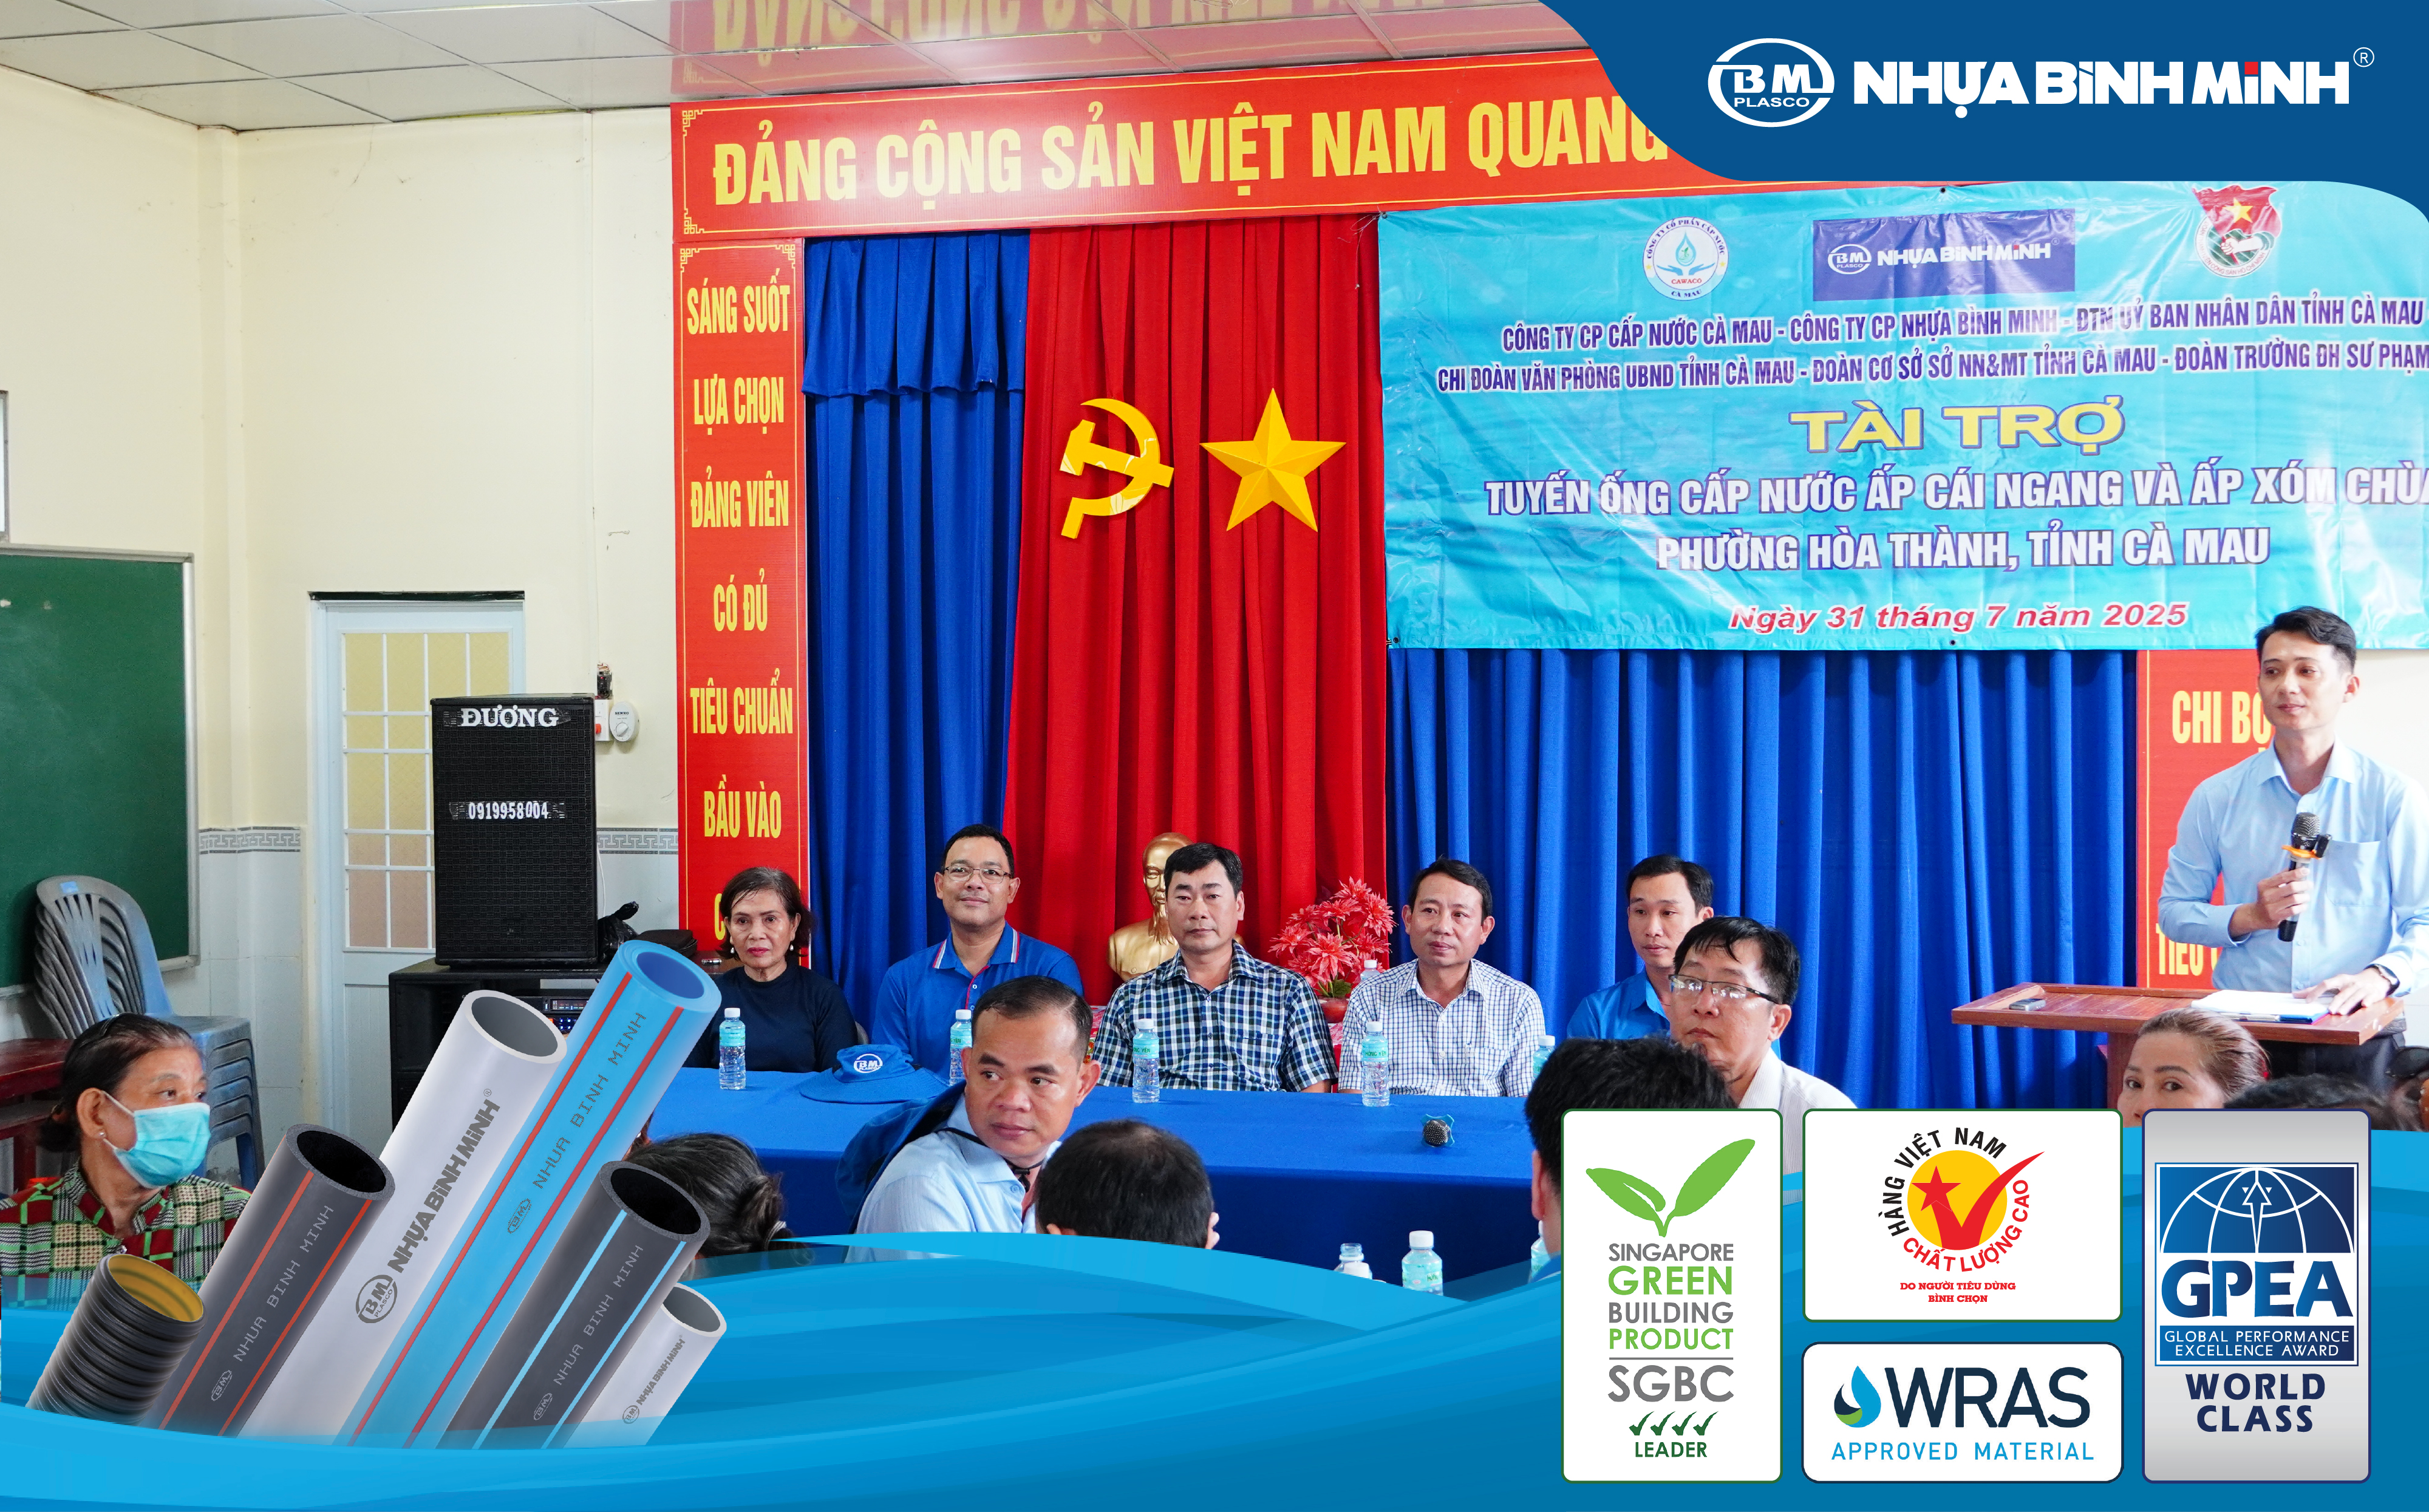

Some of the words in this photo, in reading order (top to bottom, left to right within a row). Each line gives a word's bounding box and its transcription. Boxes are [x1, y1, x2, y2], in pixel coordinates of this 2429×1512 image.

[713, 120, 857, 205] ĐẢNG
[876, 120, 1021, 210] CỘNG
[1041, 101, 1154, 190] SẢN
[1173, 101, 1292, 196] VIỆT
[1312, 105, 1446, 177] NAM
[1468, 95, 1668, 177] QUANG
[1878, 248, 1938, 268] NHỰA
[687, 278, 737, 334] SÁNG
[743, 268, 790, 333] SUỐT
[1503, 321, 1550, 352] CÔNG
[1555, 326, 1575, 349] TY
[1579, 325, 1602, 348] CP
[1608, 315, 1643, 347] CẤP
[1649, 316, 1697, 346] NƯỚC
[1703, 316, 1726, 345] CÀ
[1732, 319, 1772, 343] MAU
[1790, 313, 1839, 341] CÔNG
[1845, 316, 1866, 340] TY
[1872, 316, 1895, 339] CP
[1902, 312, 1952, 341] NHỰA
[1957, 307, 2001, 335] BÌNH
[2008, 308, 2057, 334] MINH
[2077, 307, 2113, 332] ĐTN
[2119, 297, 2144, 330] UỶ
[2150, 304, 2189, 329] BAN
[2195, 297, 2249, 327] NHÂN
[2255, 295, 2295, 325] DÂN
[2301, 291, 2344, 324] TỈNH
[2351, 294, 2376, 324] CÀ
[2381, 300, 2424, 325] MAU
[1684, 289, 1702, 298] MAU
[1438, 368, 1466, 391] CHI
[1471, 363, 1516, 390] ĐOÀN
[1521, 363, 1556, 390] VĂN
[1561, 360, 1620, 389] PHÒNG
[1626, 364, 1674, 389] UBND
[1680, 355, 1719, 386] TỈNH
[1726, 356, 1749, 385] CÀ
[1755, 361, 1794, 384] MAU
[1813, 355, 1862, 383] ĐOÀN
[1869, 356, 1893, 381] CƠ
[1898, 347, 1923, 380] SỞ
[1928, 346, 1953, 378] SỞ
[1959, 351, 2028, 378] NN&MT
[2033, 343, 2076, 375] TỈNH
[2082, 344, 2108, 374] CÀ
[2114, 347, 2156, 372] MAU
[2175, 341, 2227, 372] ĐOÀN
[2234, 337, 2310, 369] TRƯỜNG
[2316, 343, 2339, 368] ĐH
[2346, 340, 2374, 369] SƯ
[694, 373, 728, 435] LỰA
[734, 376, 785, 434] CHỌN
[1789, 400, 1924, 453] TÀI
[1942, 395, 2125, 455] TRỢ
[690, 466, 741, 528] ĐẢNG
[747, 471, 788, 527] VIÊN
[1484, 469, 1590, 516] TUYẾN
[1599, 469, 1671, 516] ỐNG
[1679, 467, 1751, 516] CẤP
[1759, 468, 1857, 514] NƯỚC
[1864, 463, 1915, 511] ẤP
[1924, 466, 1986, 511] CÁI
[1994, 470, 2123, 510] NGANG
[2131, 461, 2181, 506] VÀ
[2189, 456, 2244, 506] ẤP
[2250, 458, 2337, 505] XÓM
[1657, 527, 1800, 571] PHƯỜNG
[1808, 525, 1880, 570] HÒA
[1889, 525, 2020, 572] THÀNH,
[2026, 519, 2113, 566] TỈNH
[2122, 521, 2176, 567] CÀ
[2182, 526, 2271, 566] MAU
[714, 574, 737, 632] CÓ
[743, 568, 768, 632] ĐỦ
[1729, 605, 1818, 635] Ngày
[1827, 607, 1864, 629] 31
[1875, 605, 1976, 633] tháng
[1985, 605, 2010, 627] 7
[2015, 604, 2091, 627] năm
[2103, 603, 2189, 627] 2025
[461, 704, 559, 727] ĐƯƠNG
[690, 677, 727, 734] TIÊU
[734, 668, 792, 734] CHUẨN
[2172, 690, 2221, 744] CHI
[468, 801, 549, 820] 0919958004
[704, 774, 740, 837] BẦU
[746, 782, 782, 839] VÀO
